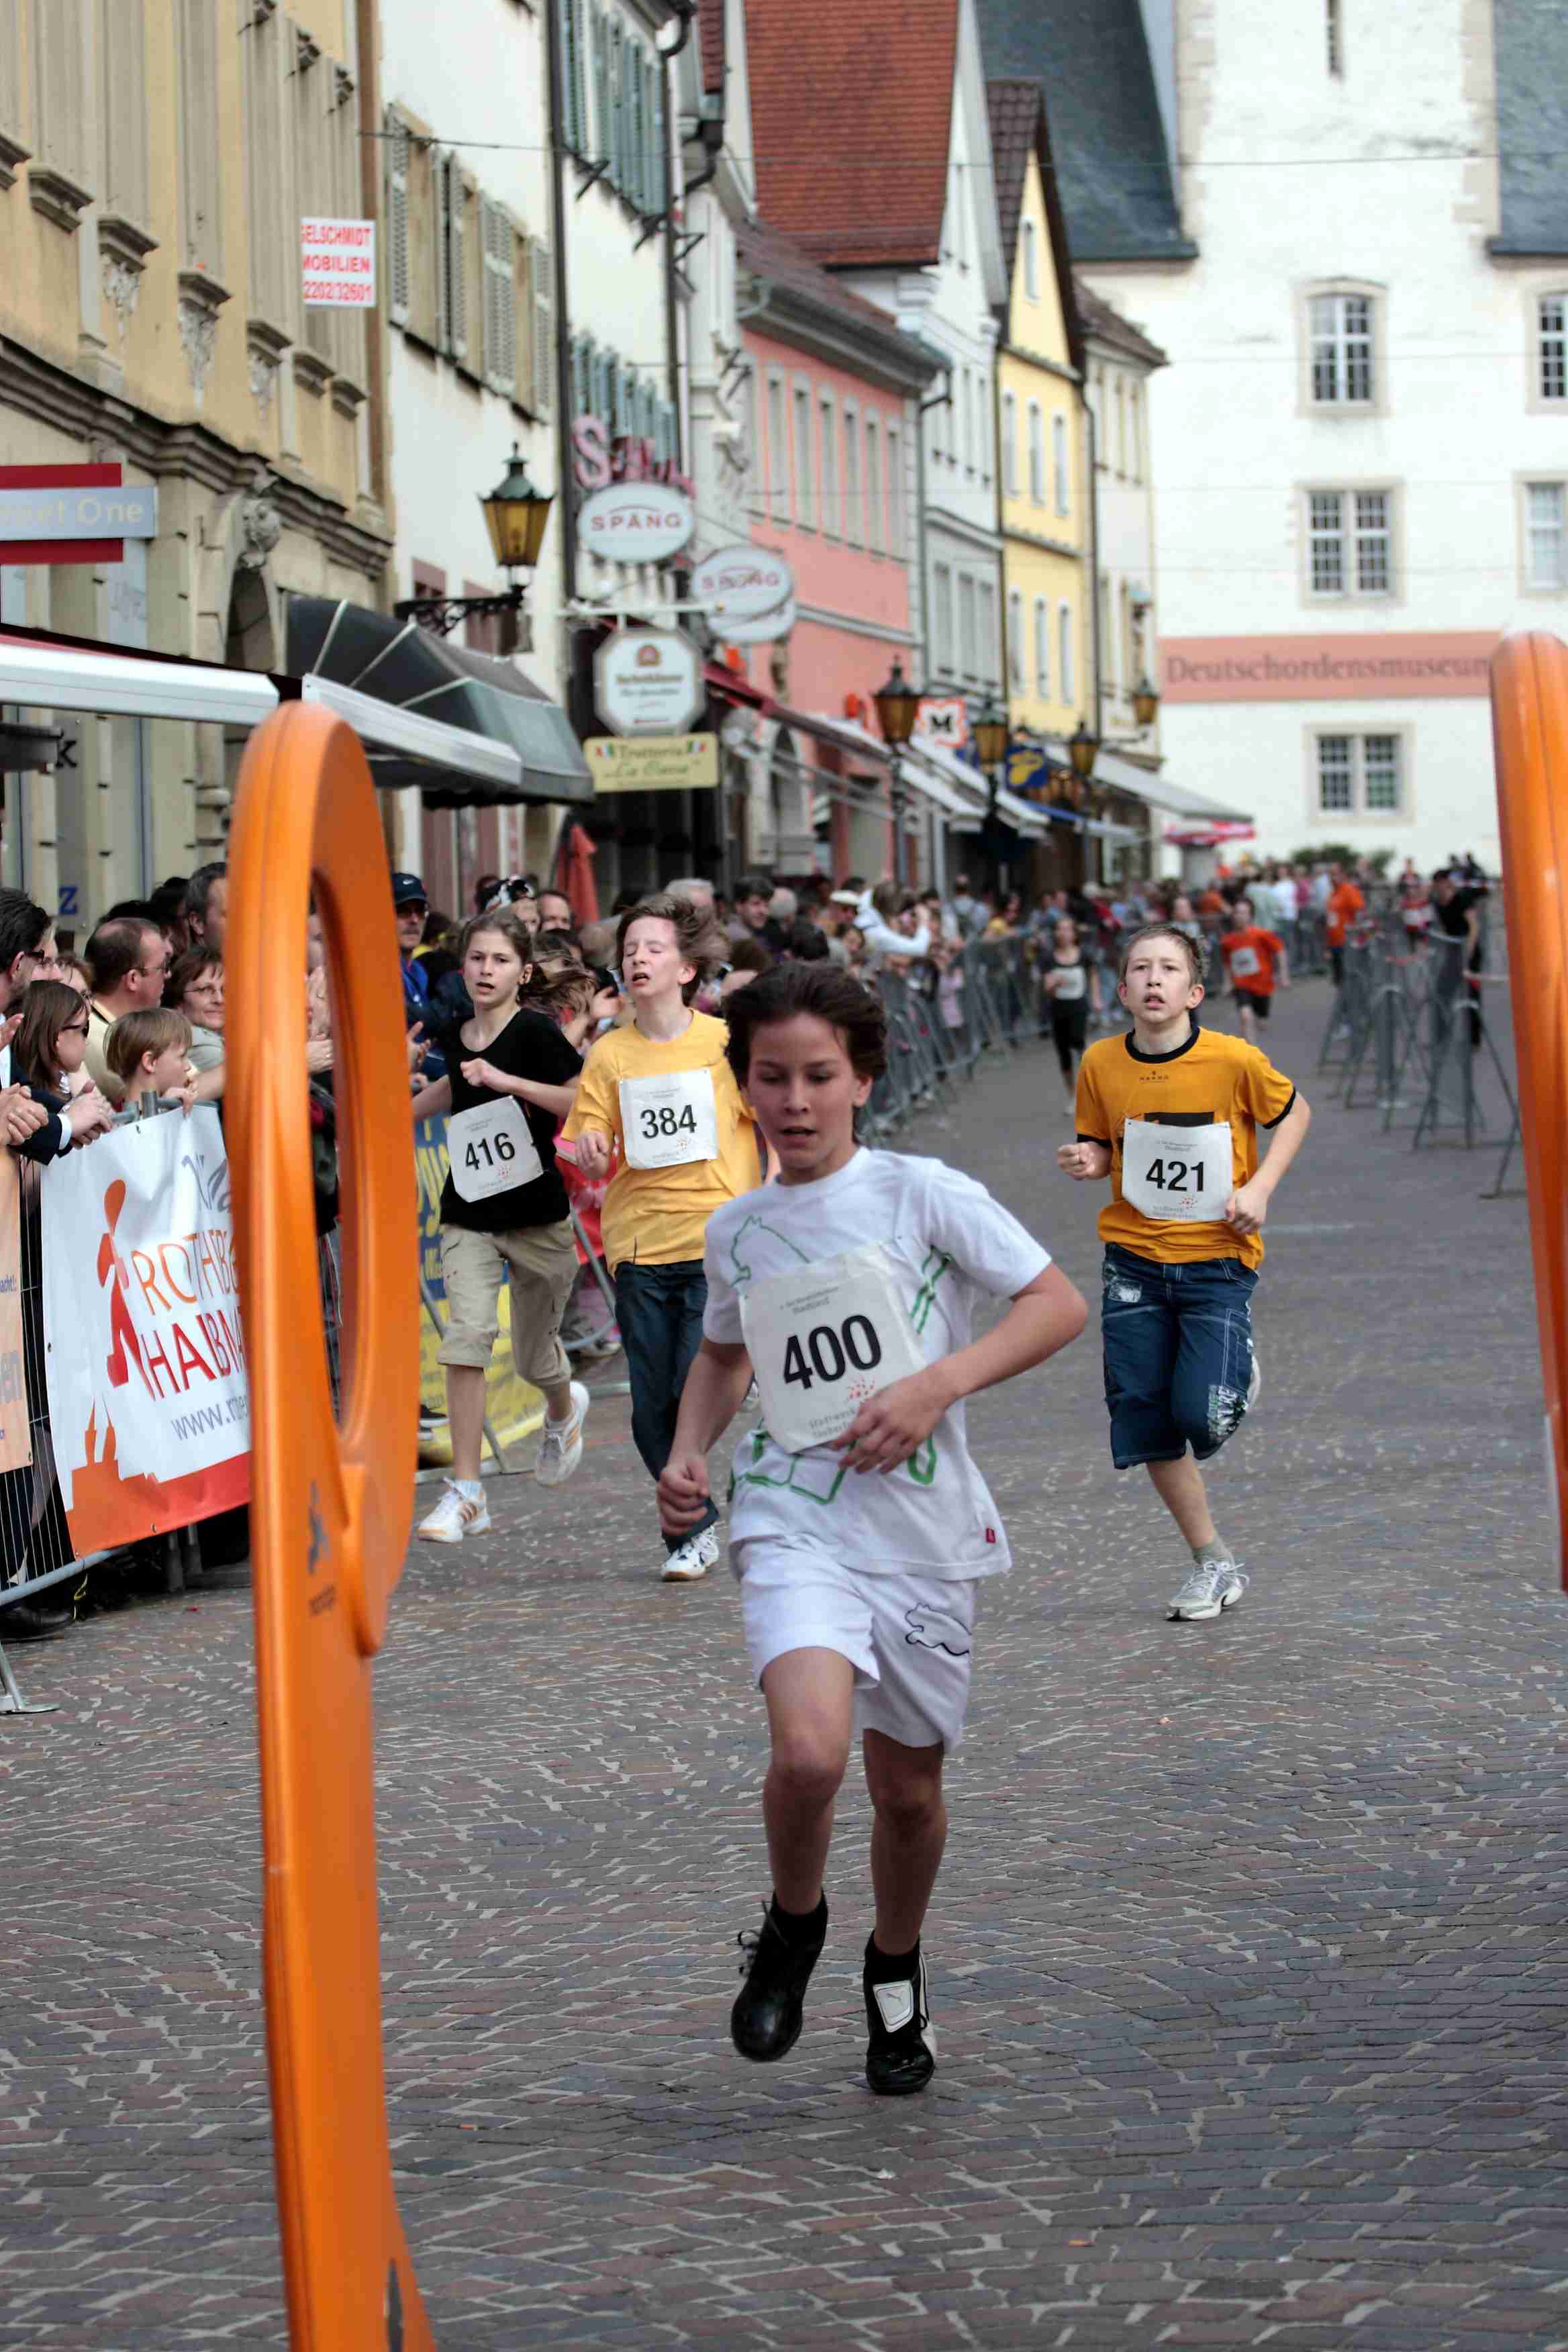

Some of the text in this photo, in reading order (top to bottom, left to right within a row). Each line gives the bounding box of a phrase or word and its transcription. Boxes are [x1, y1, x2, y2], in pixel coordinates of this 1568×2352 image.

[77, 495, 143, 526] One
[640, 1104, 697, 1139] 384
[466, 1132, 516, 1171] 416
[1146, 1159, 1204, 1192] 421
[784, 1314, 881, 1389] 400
